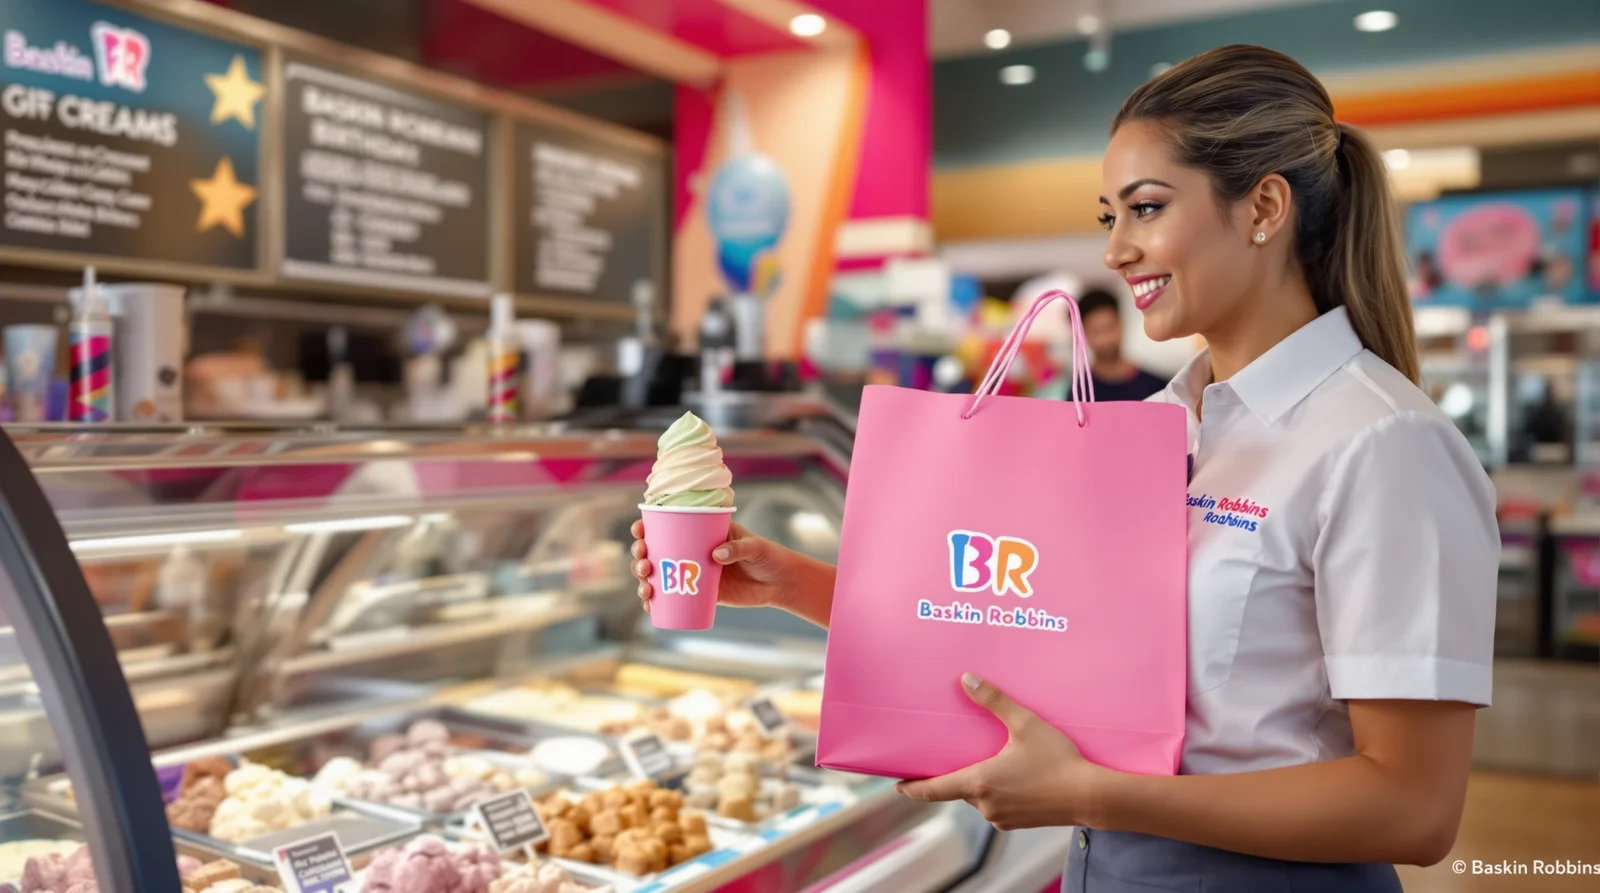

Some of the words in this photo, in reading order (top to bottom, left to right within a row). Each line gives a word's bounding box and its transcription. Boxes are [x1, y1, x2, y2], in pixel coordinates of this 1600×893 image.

[57, 94, 178, 147] CREAMS
[1216, 497, 1269, 519] Robbins
[660, 559, 700, 594] BR
[948, 531, 1037, 597] BR
[918, 600, 982, 624] Baskin
[988, 606, 1067, 631] Robbins
